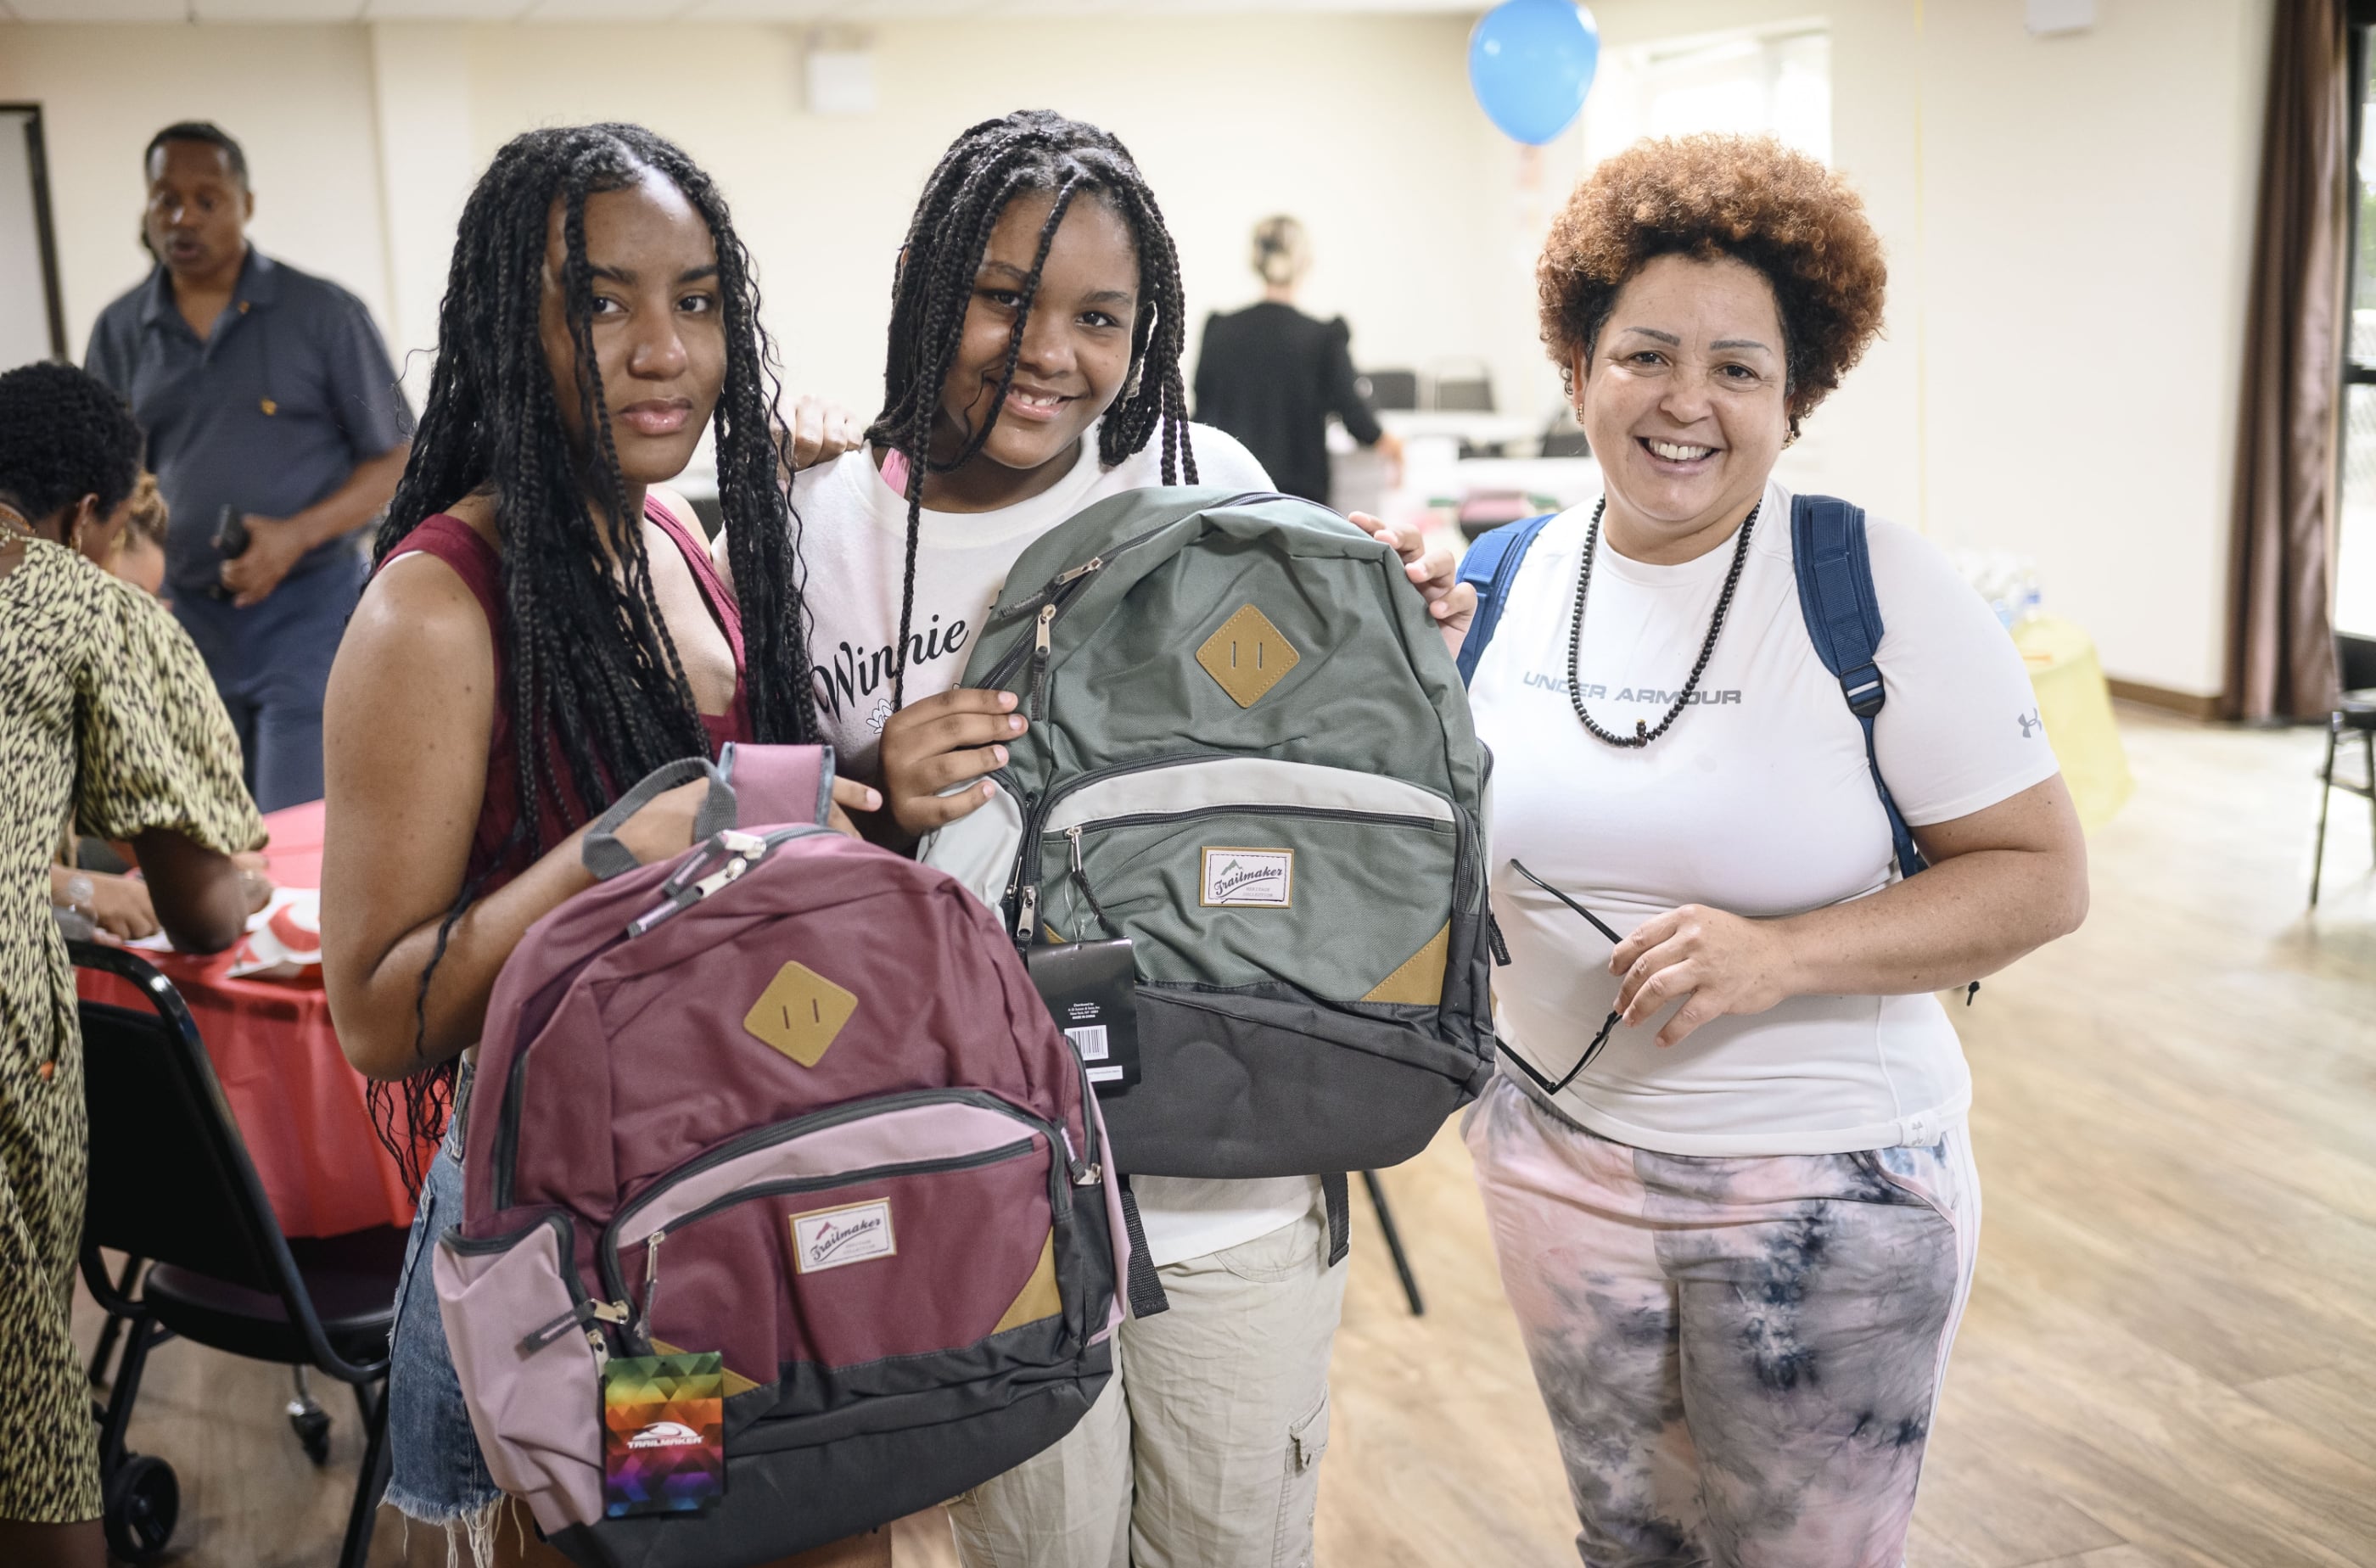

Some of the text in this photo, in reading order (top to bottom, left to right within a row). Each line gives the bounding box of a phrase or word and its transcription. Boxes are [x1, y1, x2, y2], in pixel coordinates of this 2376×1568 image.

[809, 613, 969, 724] Winnie
[1615, 688, 1742, 706] ARMOUR
[1213, 865, 1283, 896] Trailmaker
[810, 1218, 881, 1261] Trailmaker
[627, 1436, 703, 1449] TRAILMAKER
